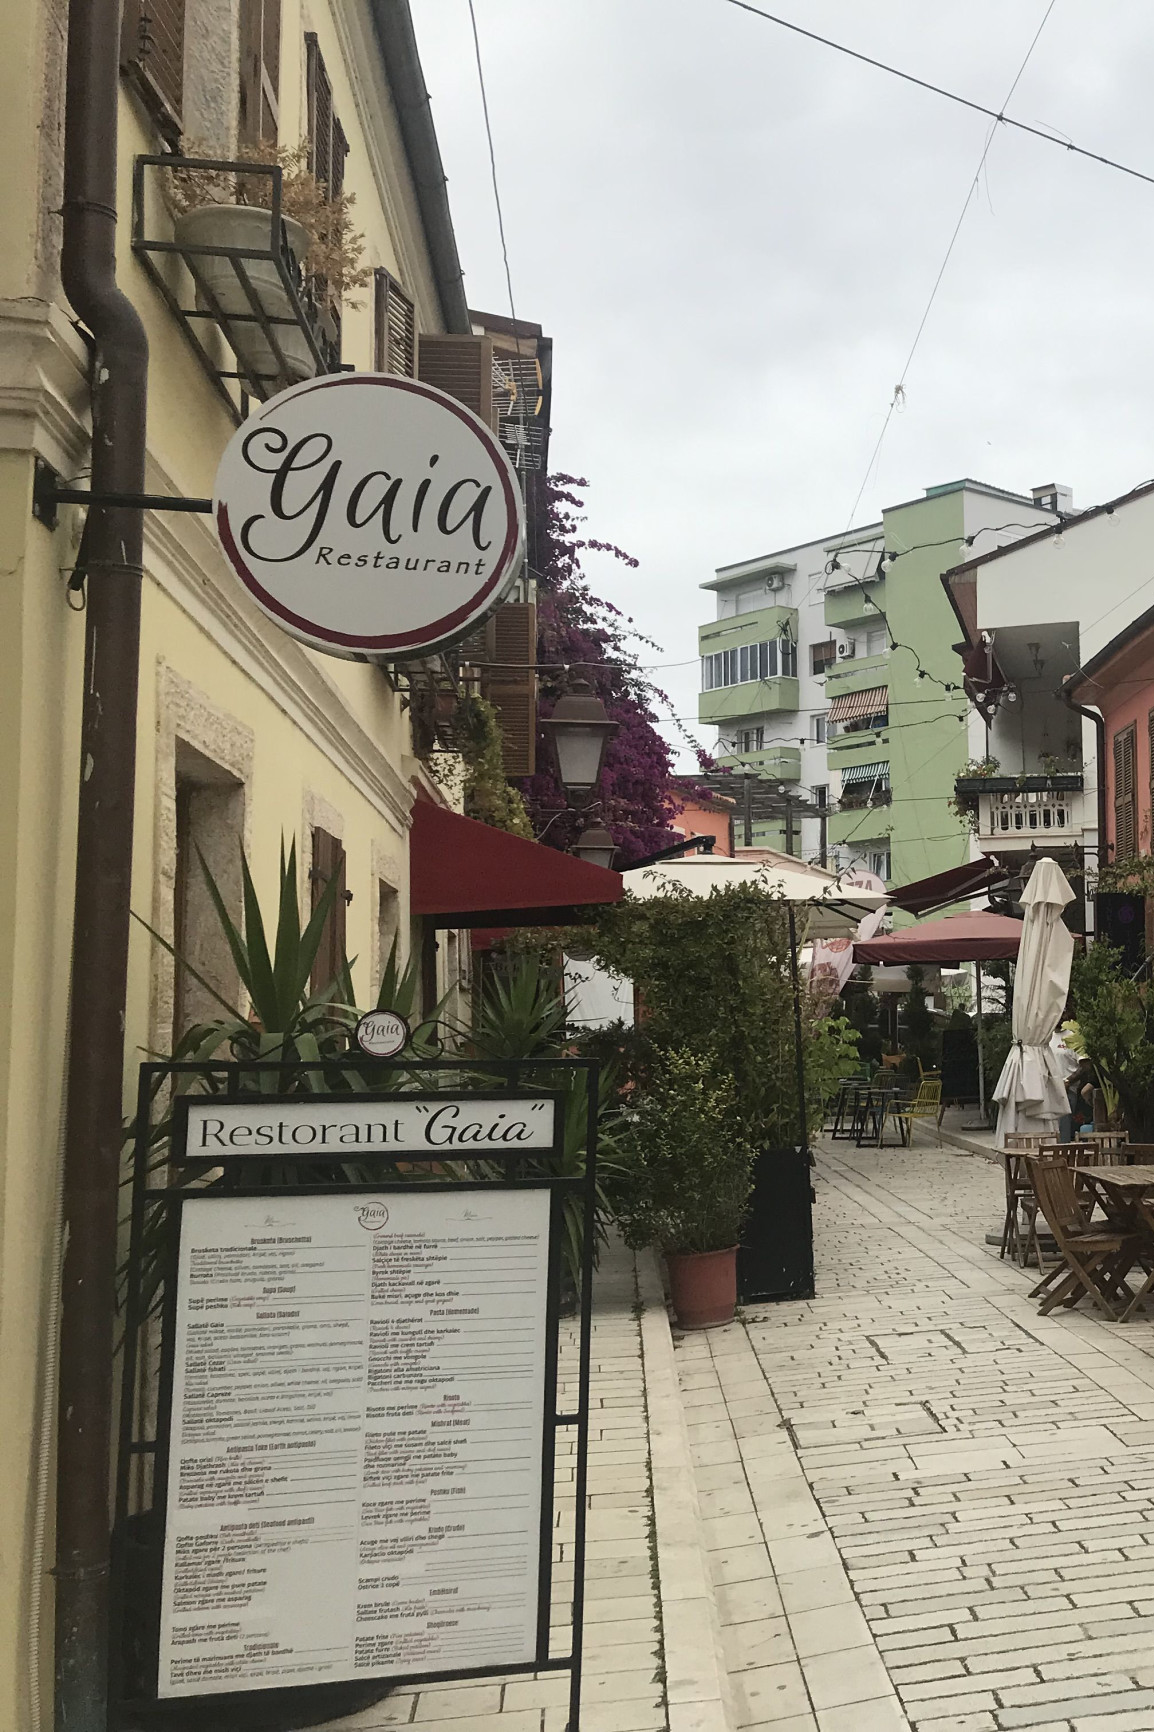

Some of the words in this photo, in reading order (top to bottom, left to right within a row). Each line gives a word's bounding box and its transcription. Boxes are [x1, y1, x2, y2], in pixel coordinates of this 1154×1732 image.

[240, 427, 492, 562] Gaia
[314, 546, 487, 576] Restaurant
[360, 1020, 400, 1042] Gaia
[198, 1118, 406, 1148] Restorant
